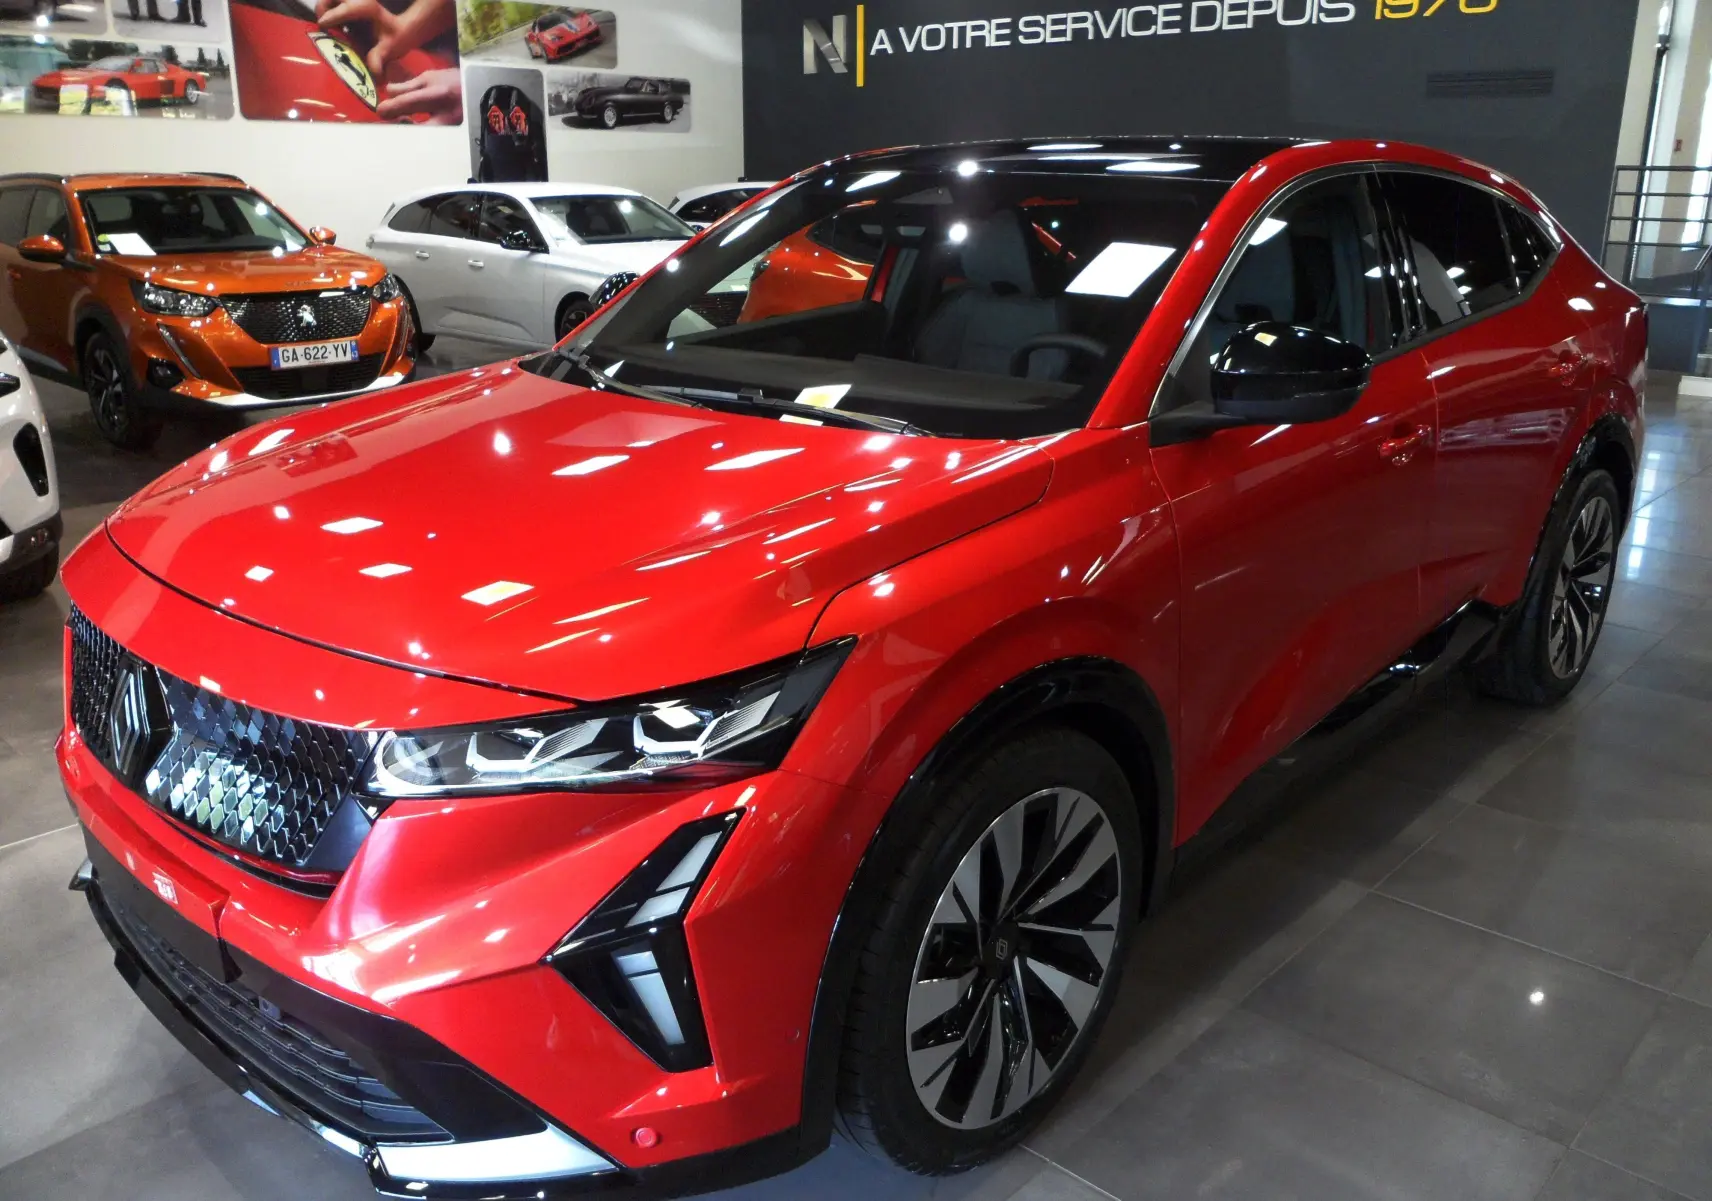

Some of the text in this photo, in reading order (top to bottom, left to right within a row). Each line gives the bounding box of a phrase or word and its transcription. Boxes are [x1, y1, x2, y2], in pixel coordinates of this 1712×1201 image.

[869, 28, 894, 56] A
[898, 17, 1013, 53] VOTRE
[1017, 3, 1183, 45] SERVICE
[1189, 0, 1356, 33] DEPUIS
[281, 343, 348, 363] GA-622-YV
